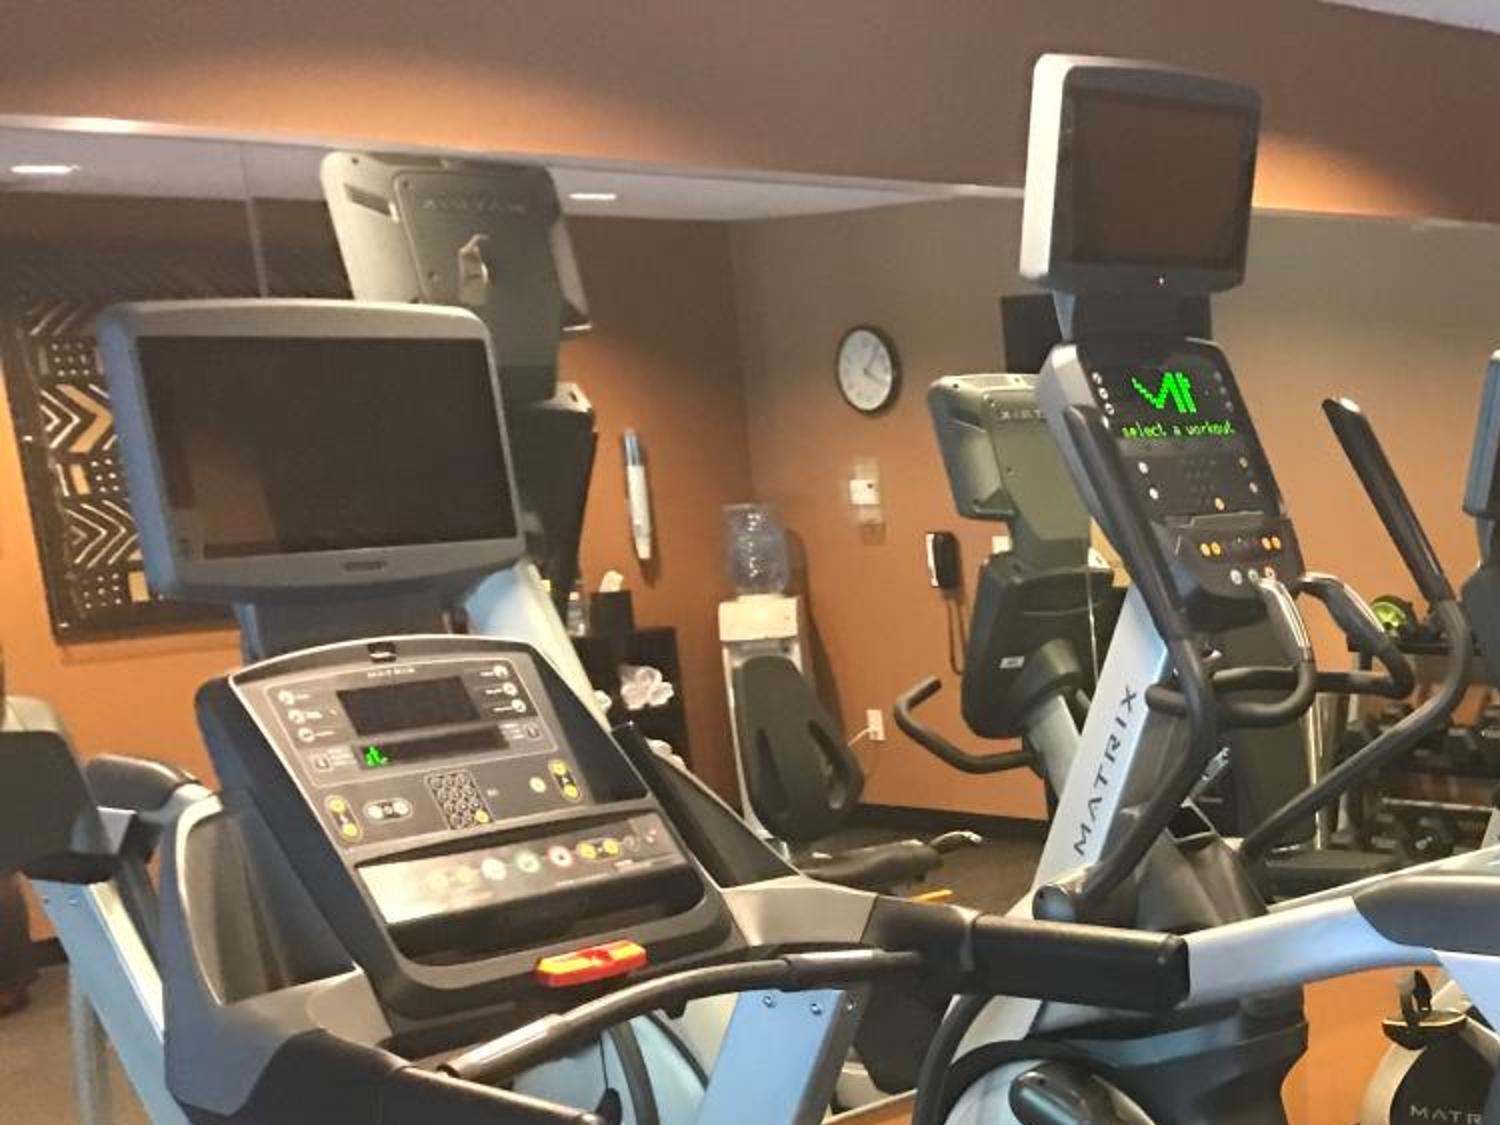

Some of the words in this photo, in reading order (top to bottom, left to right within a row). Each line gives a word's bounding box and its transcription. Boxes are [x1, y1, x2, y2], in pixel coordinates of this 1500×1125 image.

[1121, 421, 1167, 438] select
[1173, 425, 1182, 436] a
[1186, 419, 1235, 436] workout
[1073, 684, 1137, 857] MATRIX
[1409, 1104, 1483, 1125] MATR
